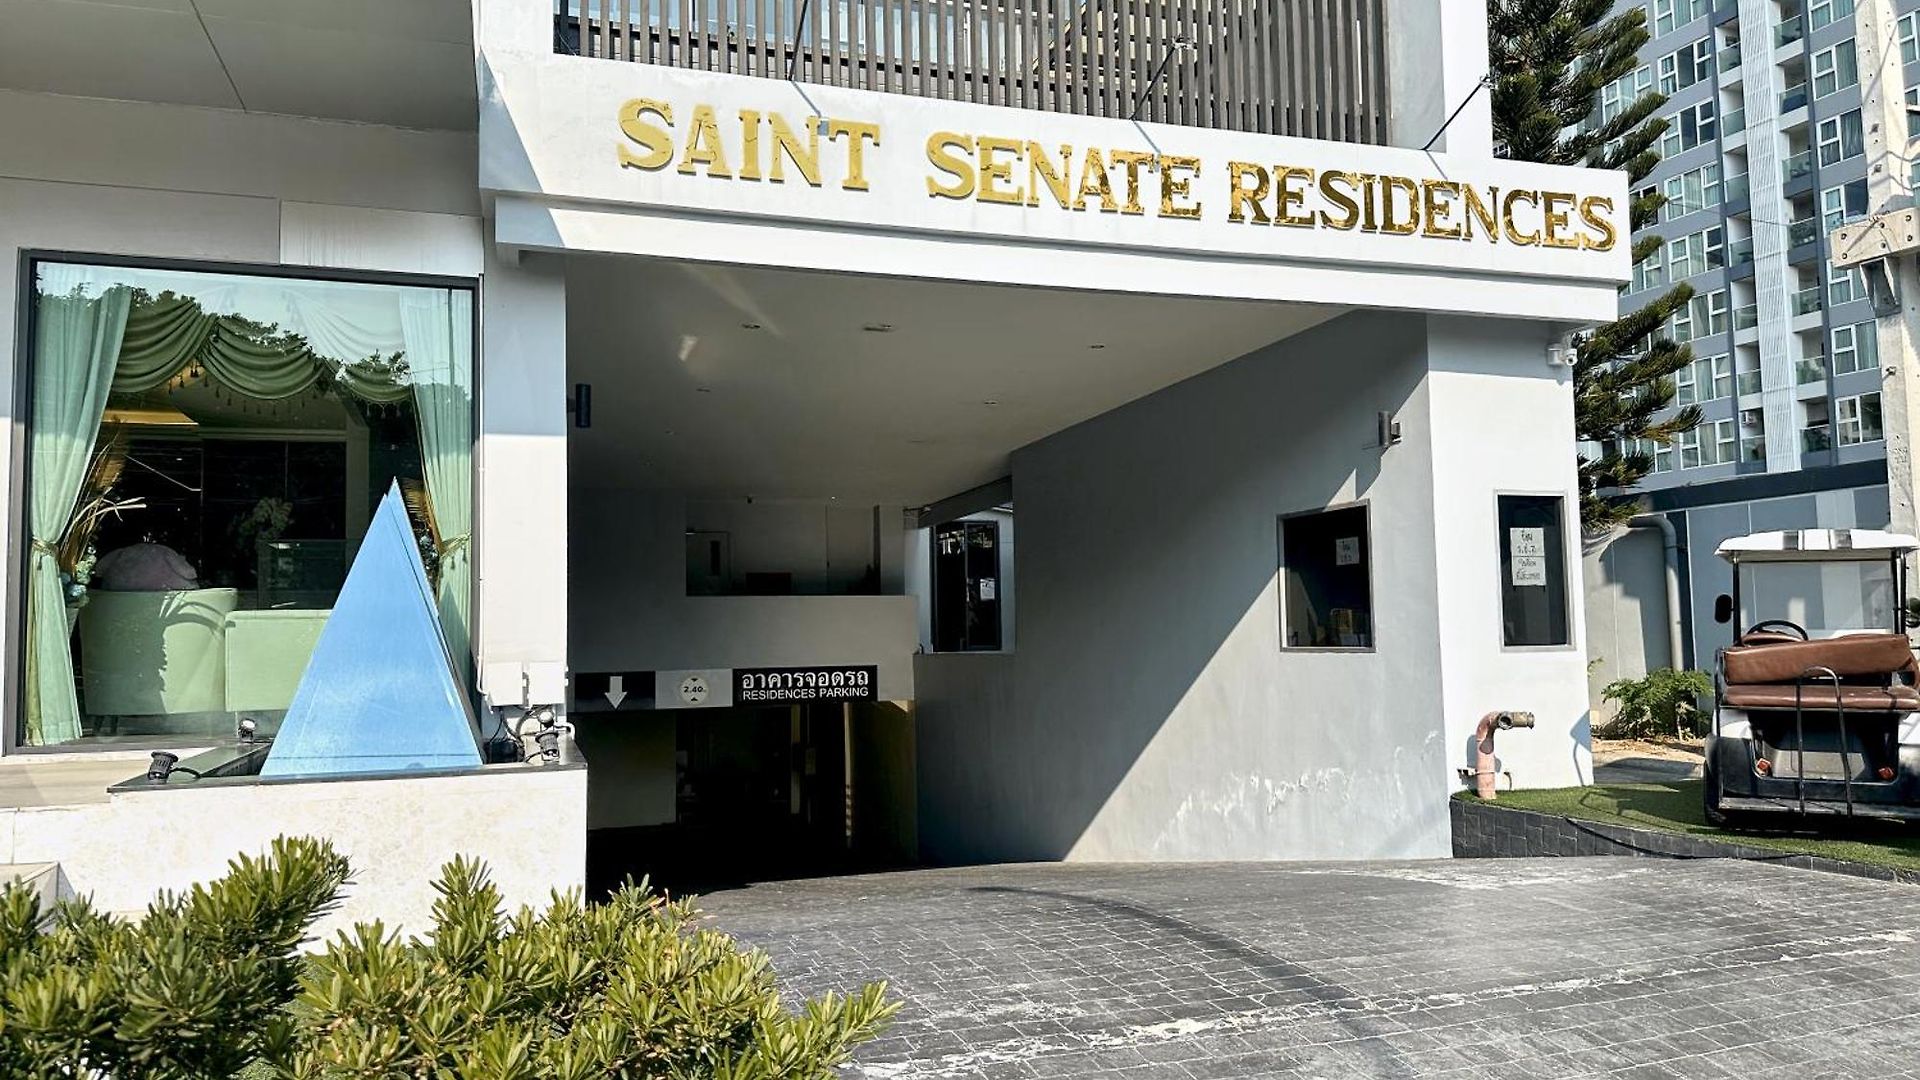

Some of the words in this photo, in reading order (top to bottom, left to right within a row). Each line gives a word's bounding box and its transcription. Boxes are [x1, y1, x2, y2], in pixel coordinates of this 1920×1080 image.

[616, 98, 881, 192] SAINT
[926, 131, 1203, 221] SENATE
[1227, 161, 1617, 252] RESIDENCES
[742, 671, 869, 689] อาคารจอดรถ
[743, 688, 816, 700] RESIDENCES
[819, 686, 869, 698] PARKING
